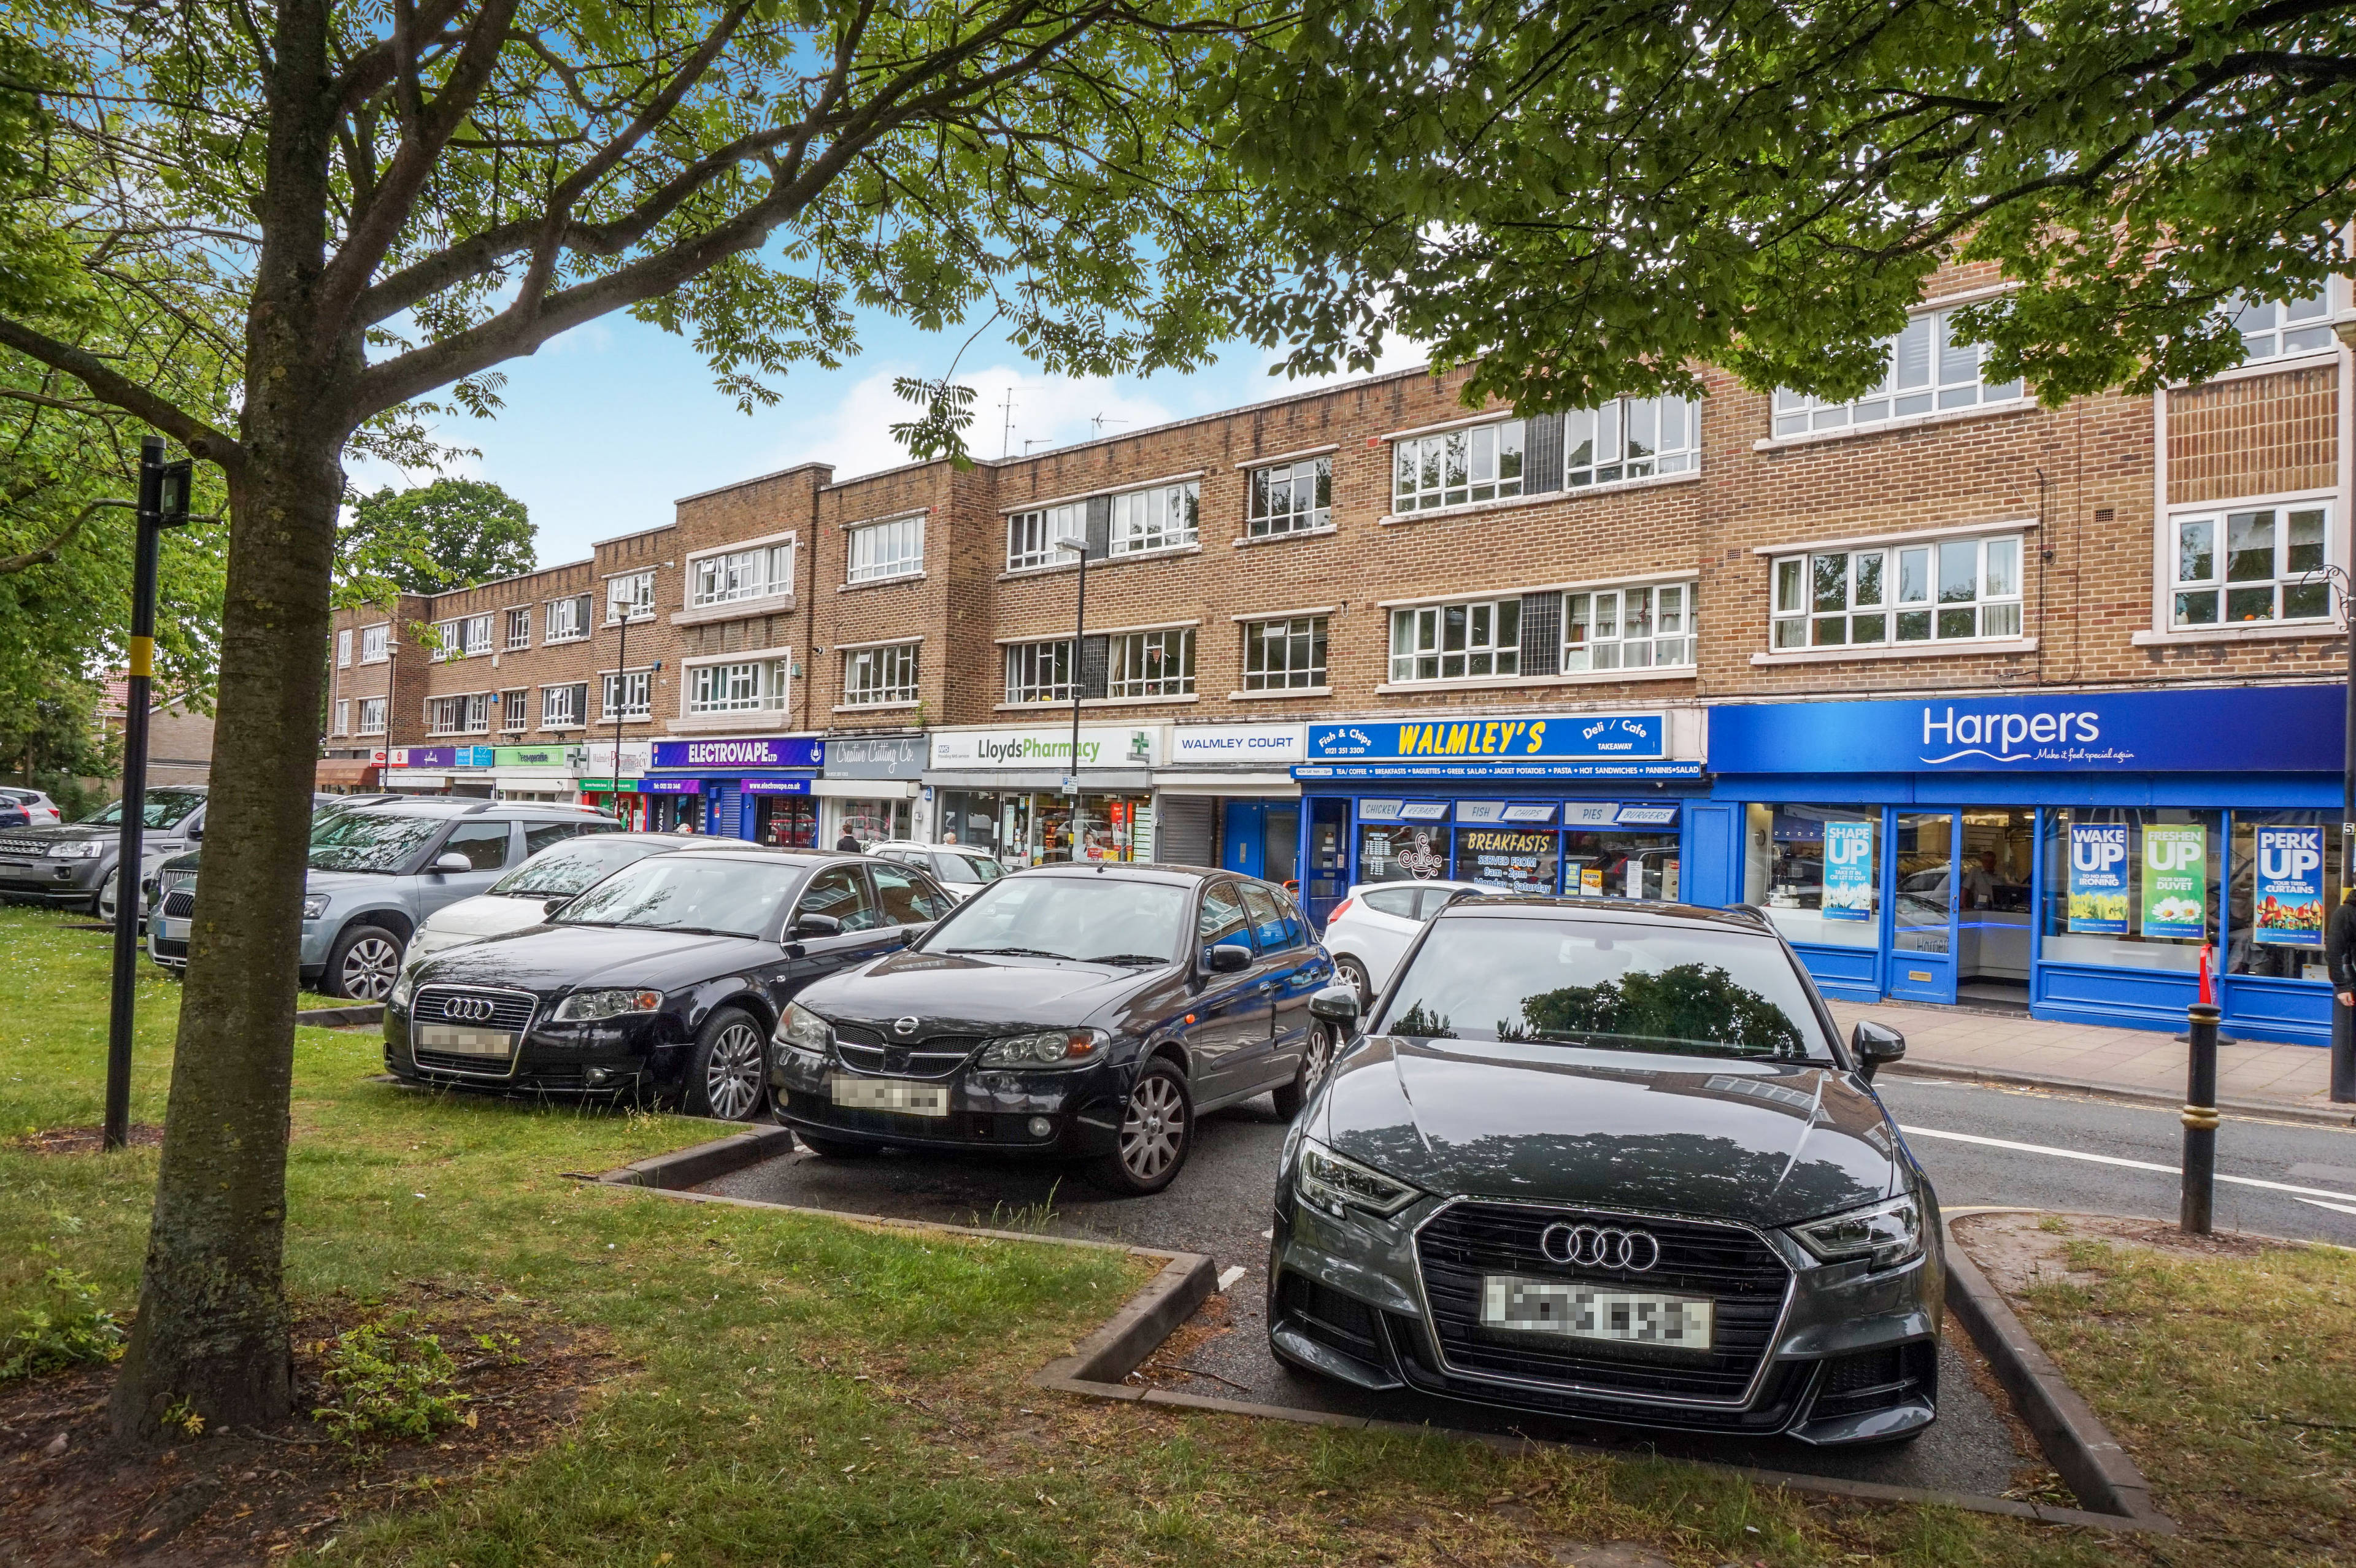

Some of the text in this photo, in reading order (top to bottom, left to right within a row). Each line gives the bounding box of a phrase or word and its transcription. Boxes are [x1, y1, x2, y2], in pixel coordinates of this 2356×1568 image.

[1319, 728, 1372, 748] Fish & Chips
[1398, 721, 1546, 755] WALMLEY'S
[1582, 721, 1604, 740] Deli
[1622, 720, 1647, 738] Cafe
[1923, 707, 2100, 753] Harpers
[978, 737, 1101, 763] LloydsPharmacy
[1182, 737, 1294, 748] WALMLEY COURT
[688, 742, 768, 763] ELECTROVAPE
[836, 739, 914, 774] Creative Cutting Co.
[2033, 748, 2135, 763] Make it feel special again
[1366, 804, 1396, 814] CHICKEN
[1472, 807, 1490, 817] FISH
[1582, 809, 1603, 820] PIES
[1623, 810, 1670, 820] BURGERS
[1829, 828, 1869, 839] SHAPE
[2073, 829, 2124, 843] WAKE
[2148, 831, 2201, 841] FRESHEN
[2345, 824, 2352, 834] 5
[1467, 832, 1550, 852] BREAKFASTS
[2261, 832, 2319, 849] PERK
[1828, 839, 1869, 864] UP
[2074, 843, 2124, 871] UP
[2148, 841, 2201, 870] UP
[1477, 855, 1536, 867] SERVED FROM
[2260, 848, 2319, 880] UP
[1484, 868, 1501, 877] 9am
[1508, 868, 1527, 879] 2pm
[1474, 877, 1506, 889] Monday
[1513, 880, 1551, 894] Saturday
[2265, 885, 2314, 894] CURTAINS
[1917, 937, 1949, 953] Harper
